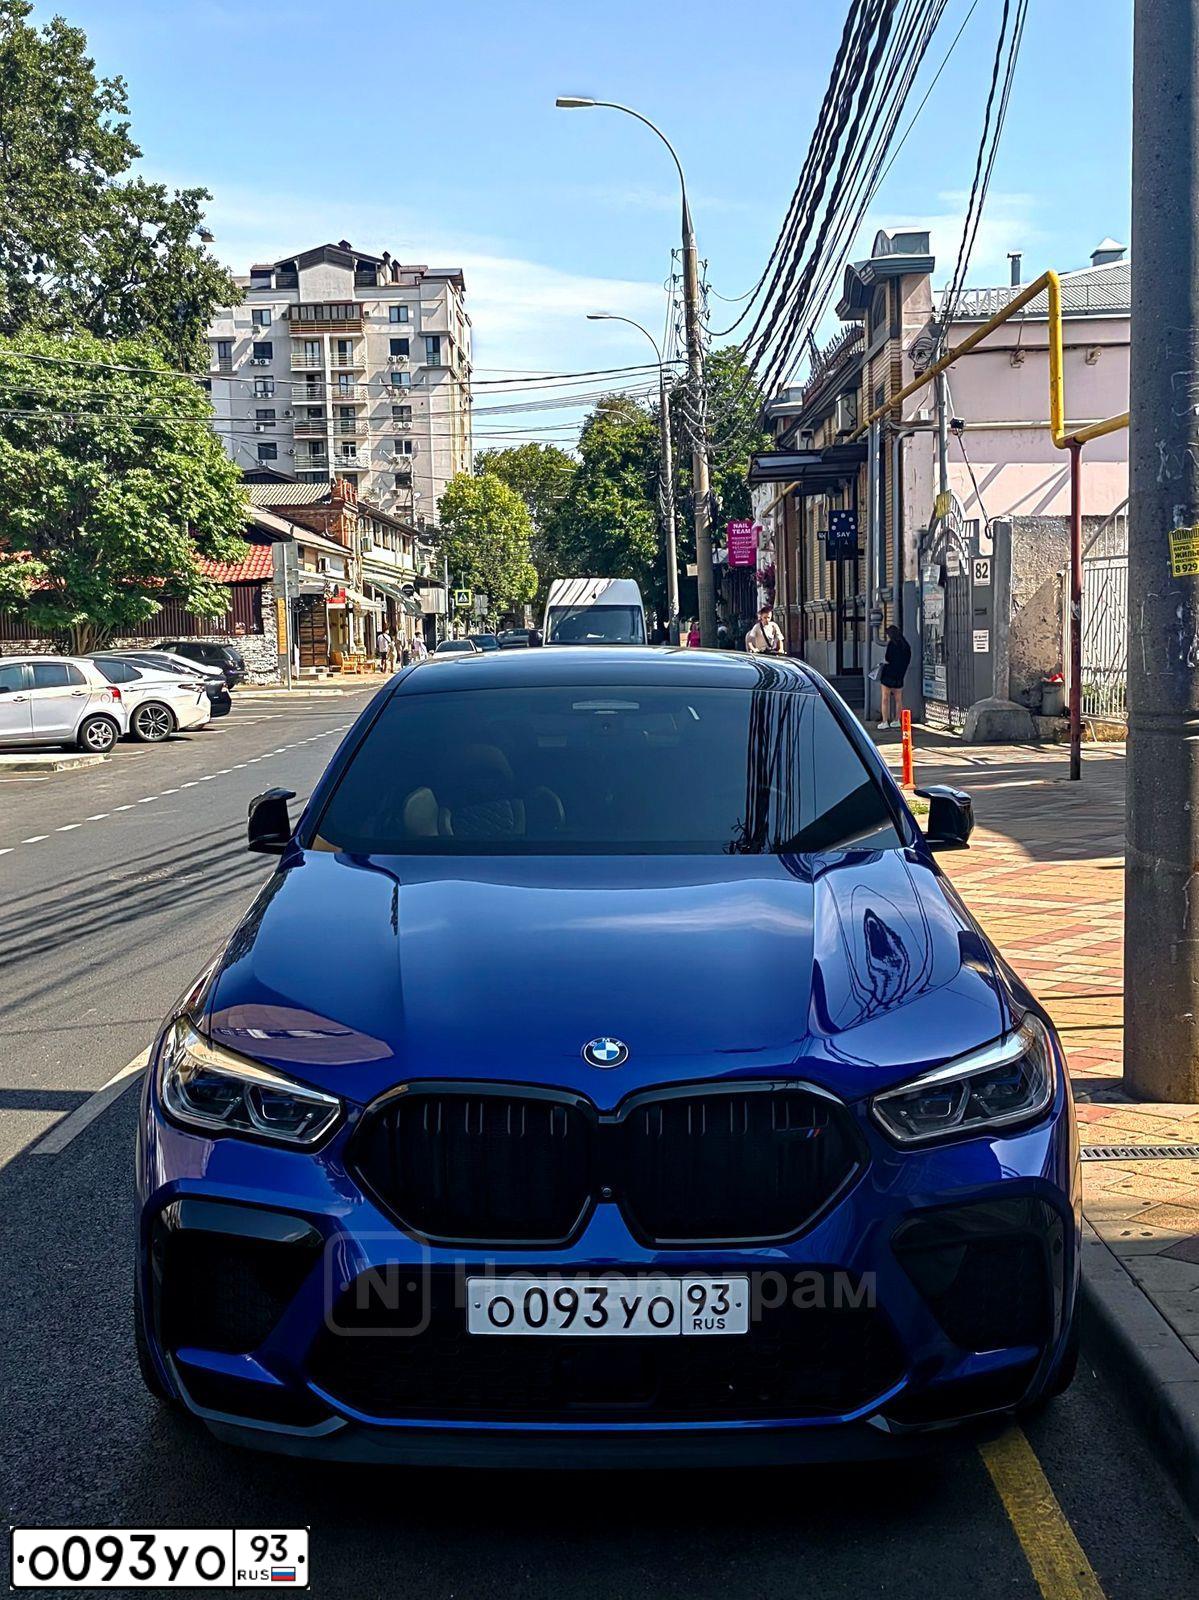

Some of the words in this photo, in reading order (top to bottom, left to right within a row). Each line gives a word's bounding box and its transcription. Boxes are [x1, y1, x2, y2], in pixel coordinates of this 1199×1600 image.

[975, 562, 988, 579] 82
[687, 1284, 730, 1316] 93
[693, 1318, 726, 1330] RUS
